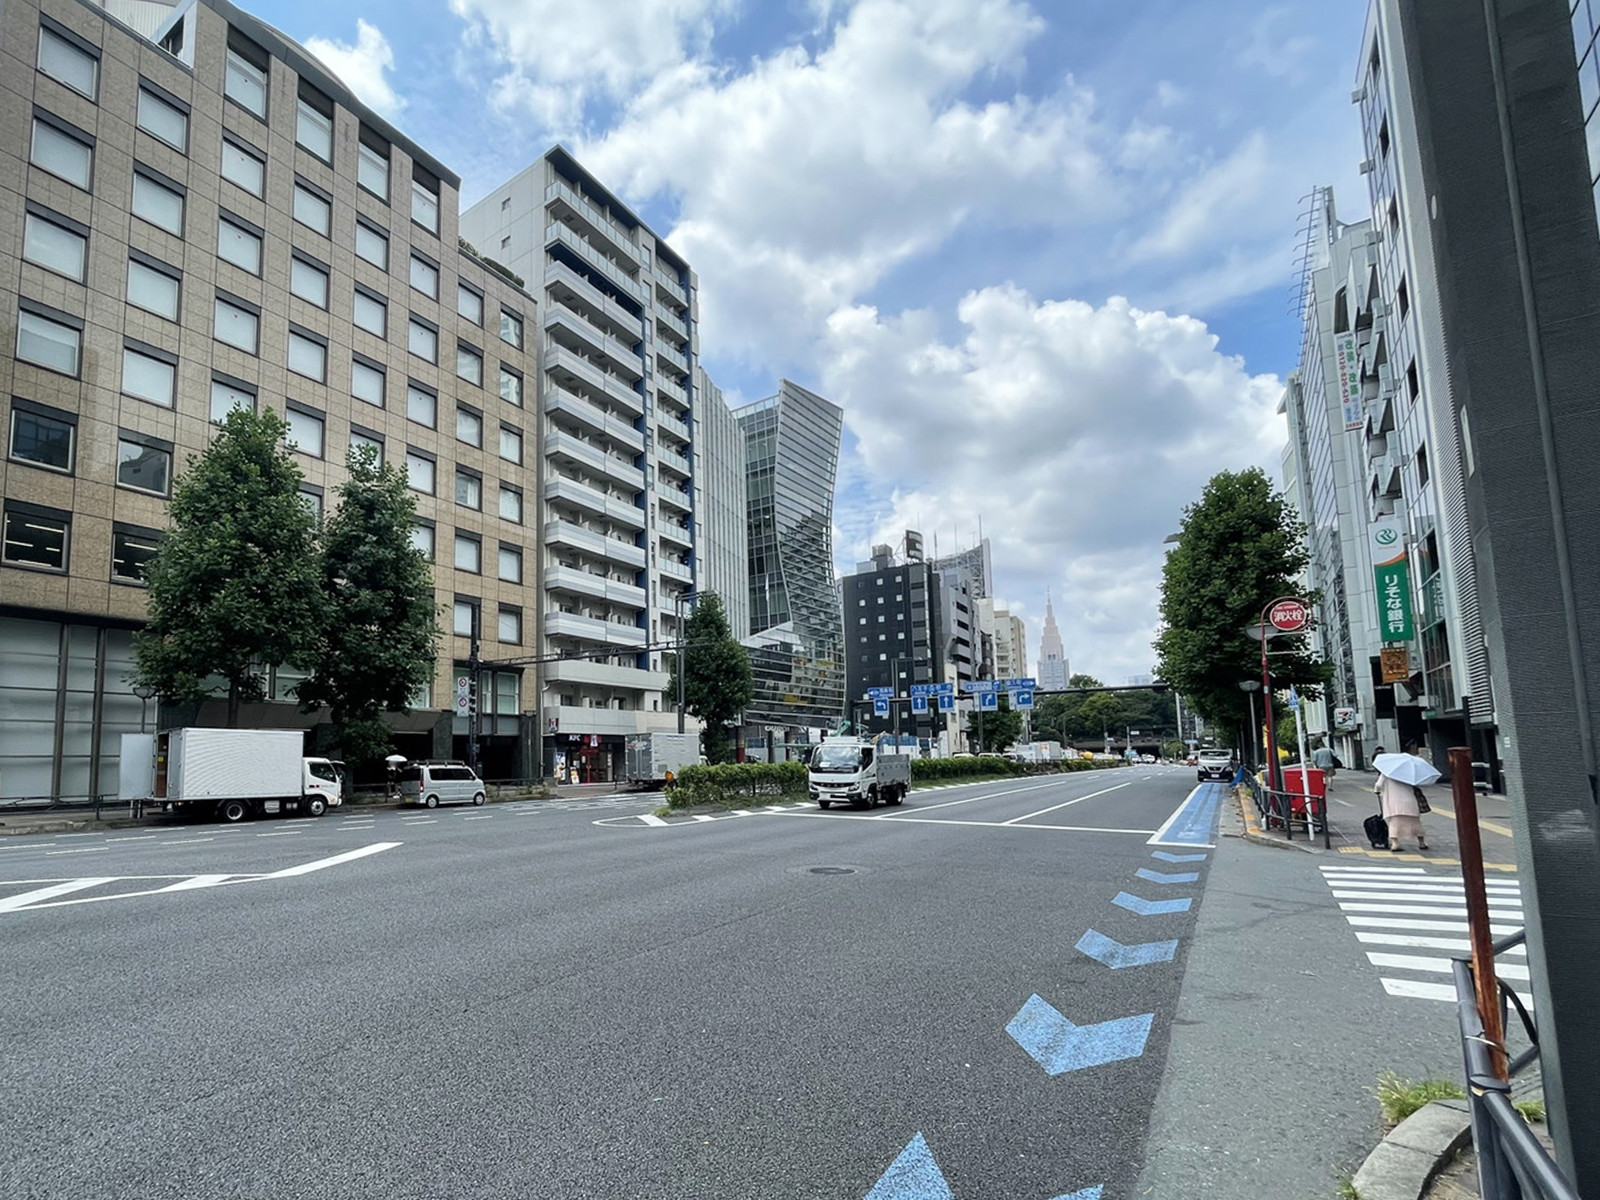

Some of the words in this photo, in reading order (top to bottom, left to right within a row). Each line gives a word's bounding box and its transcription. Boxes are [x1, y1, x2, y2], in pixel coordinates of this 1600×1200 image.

[1273, 609, 1303, 622] 消火栓
[1384, 574, 1405, 633] りそな銀行
